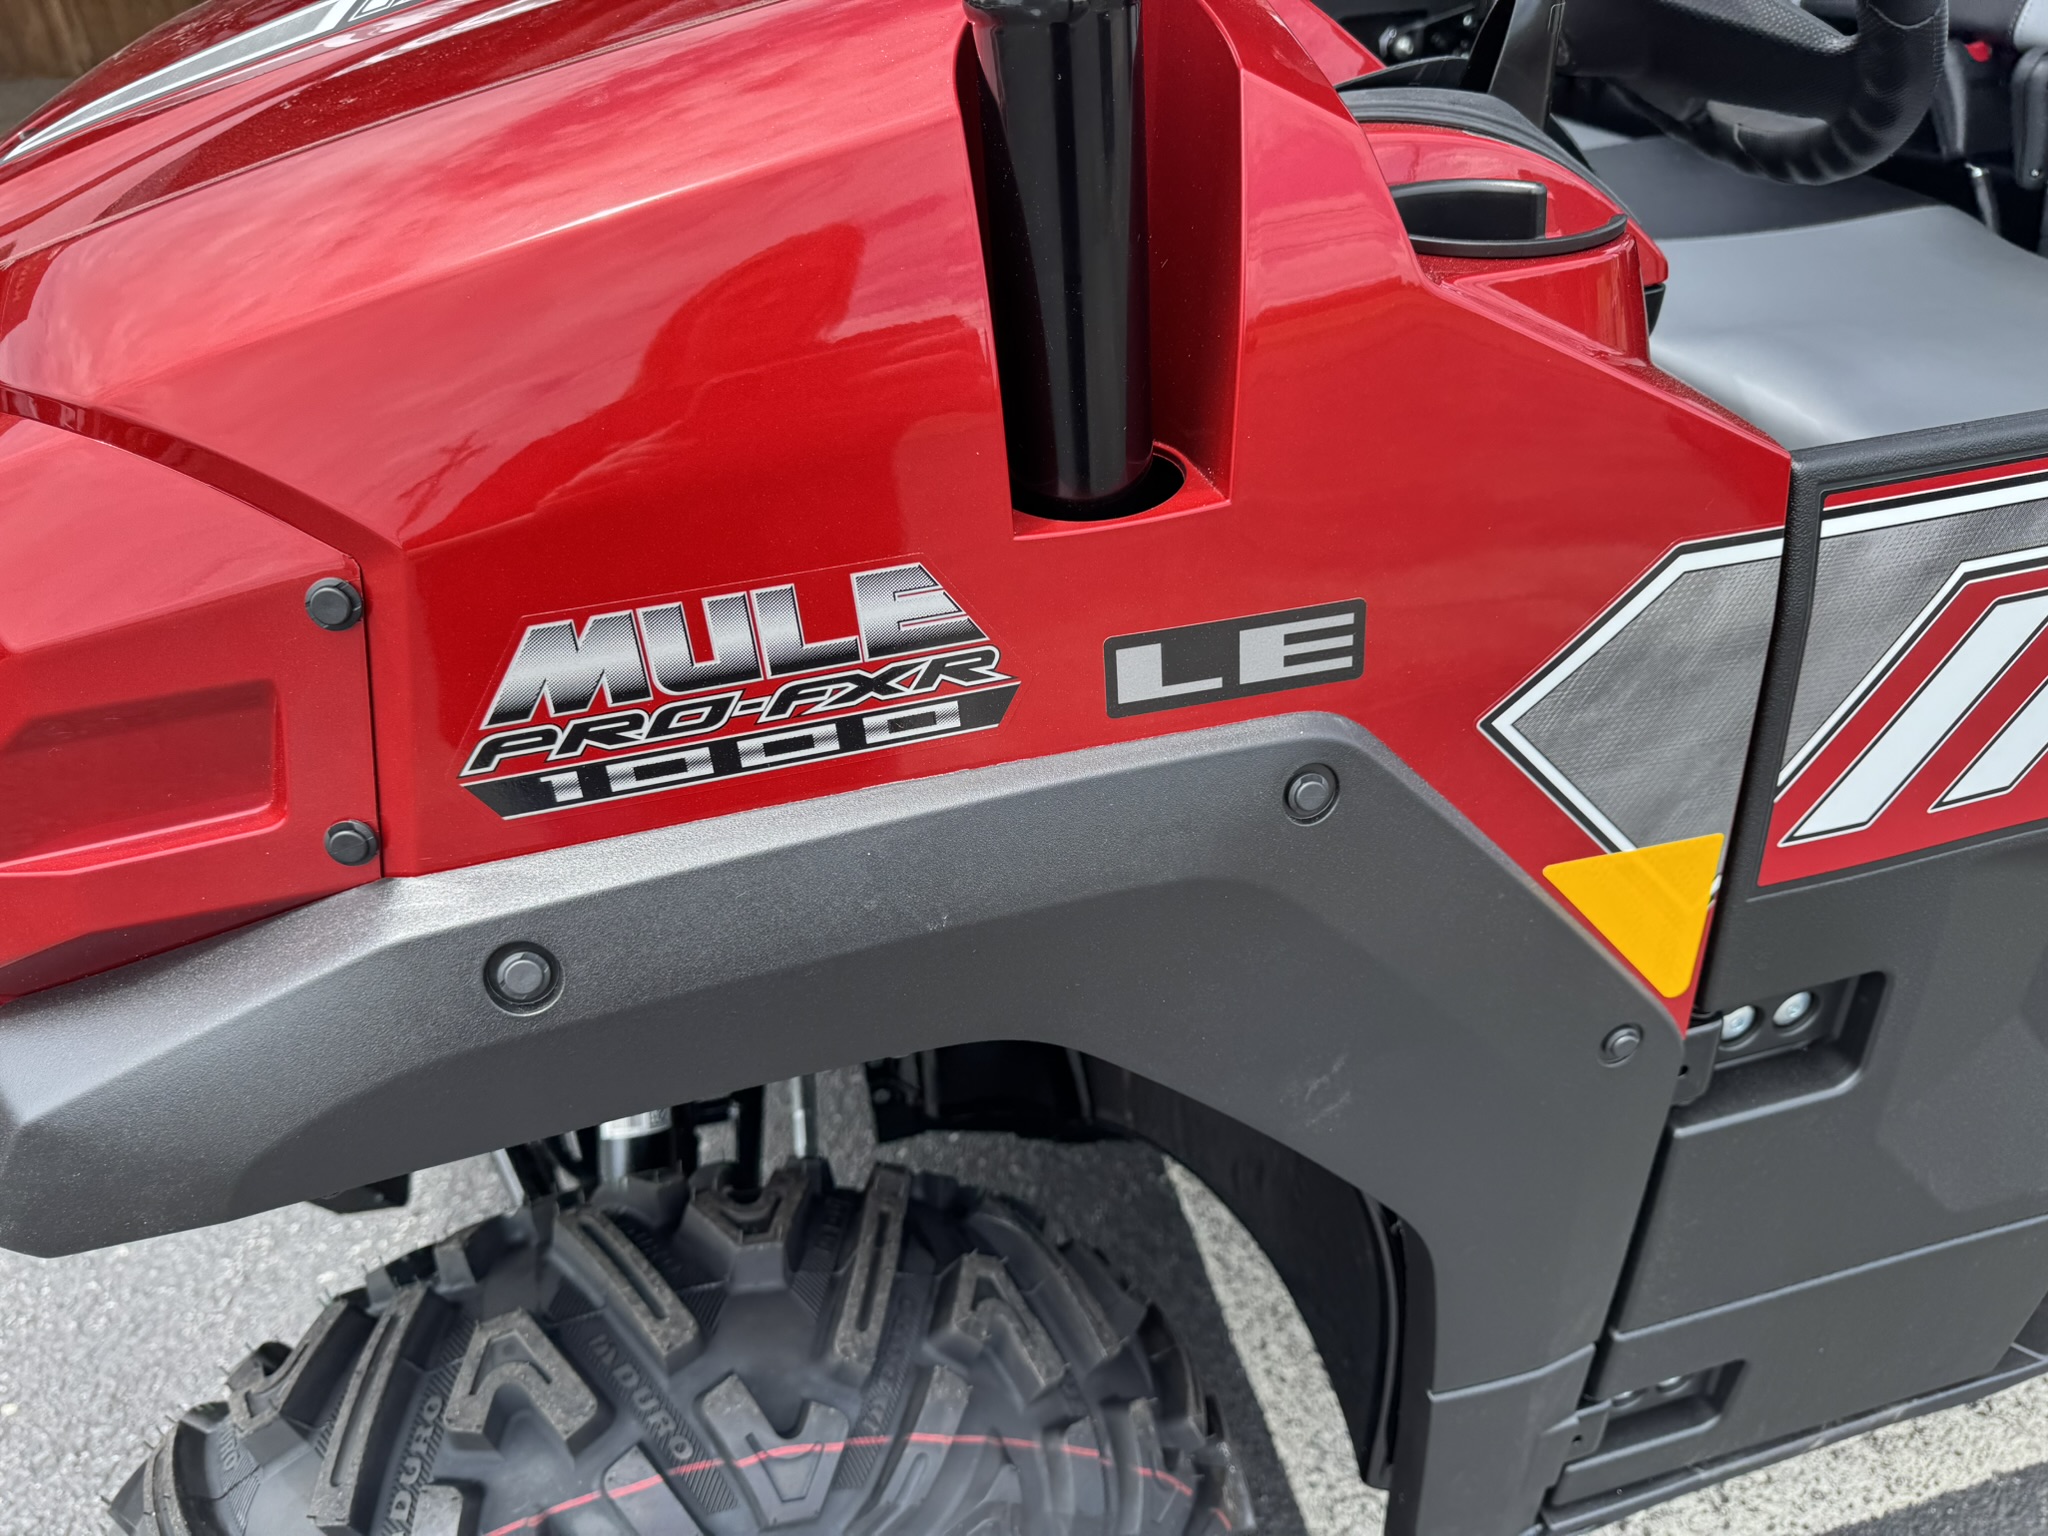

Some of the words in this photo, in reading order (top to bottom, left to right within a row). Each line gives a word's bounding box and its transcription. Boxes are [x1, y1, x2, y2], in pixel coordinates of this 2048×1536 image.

[458, 645, 1020, 777] PRO-FXR
[480, 562, 990, 729] MULE
[1115, 612, 1355, 704] LE
[540, 701, 962, 802] 1000
[389, 1394, 443, 1536] DURO
